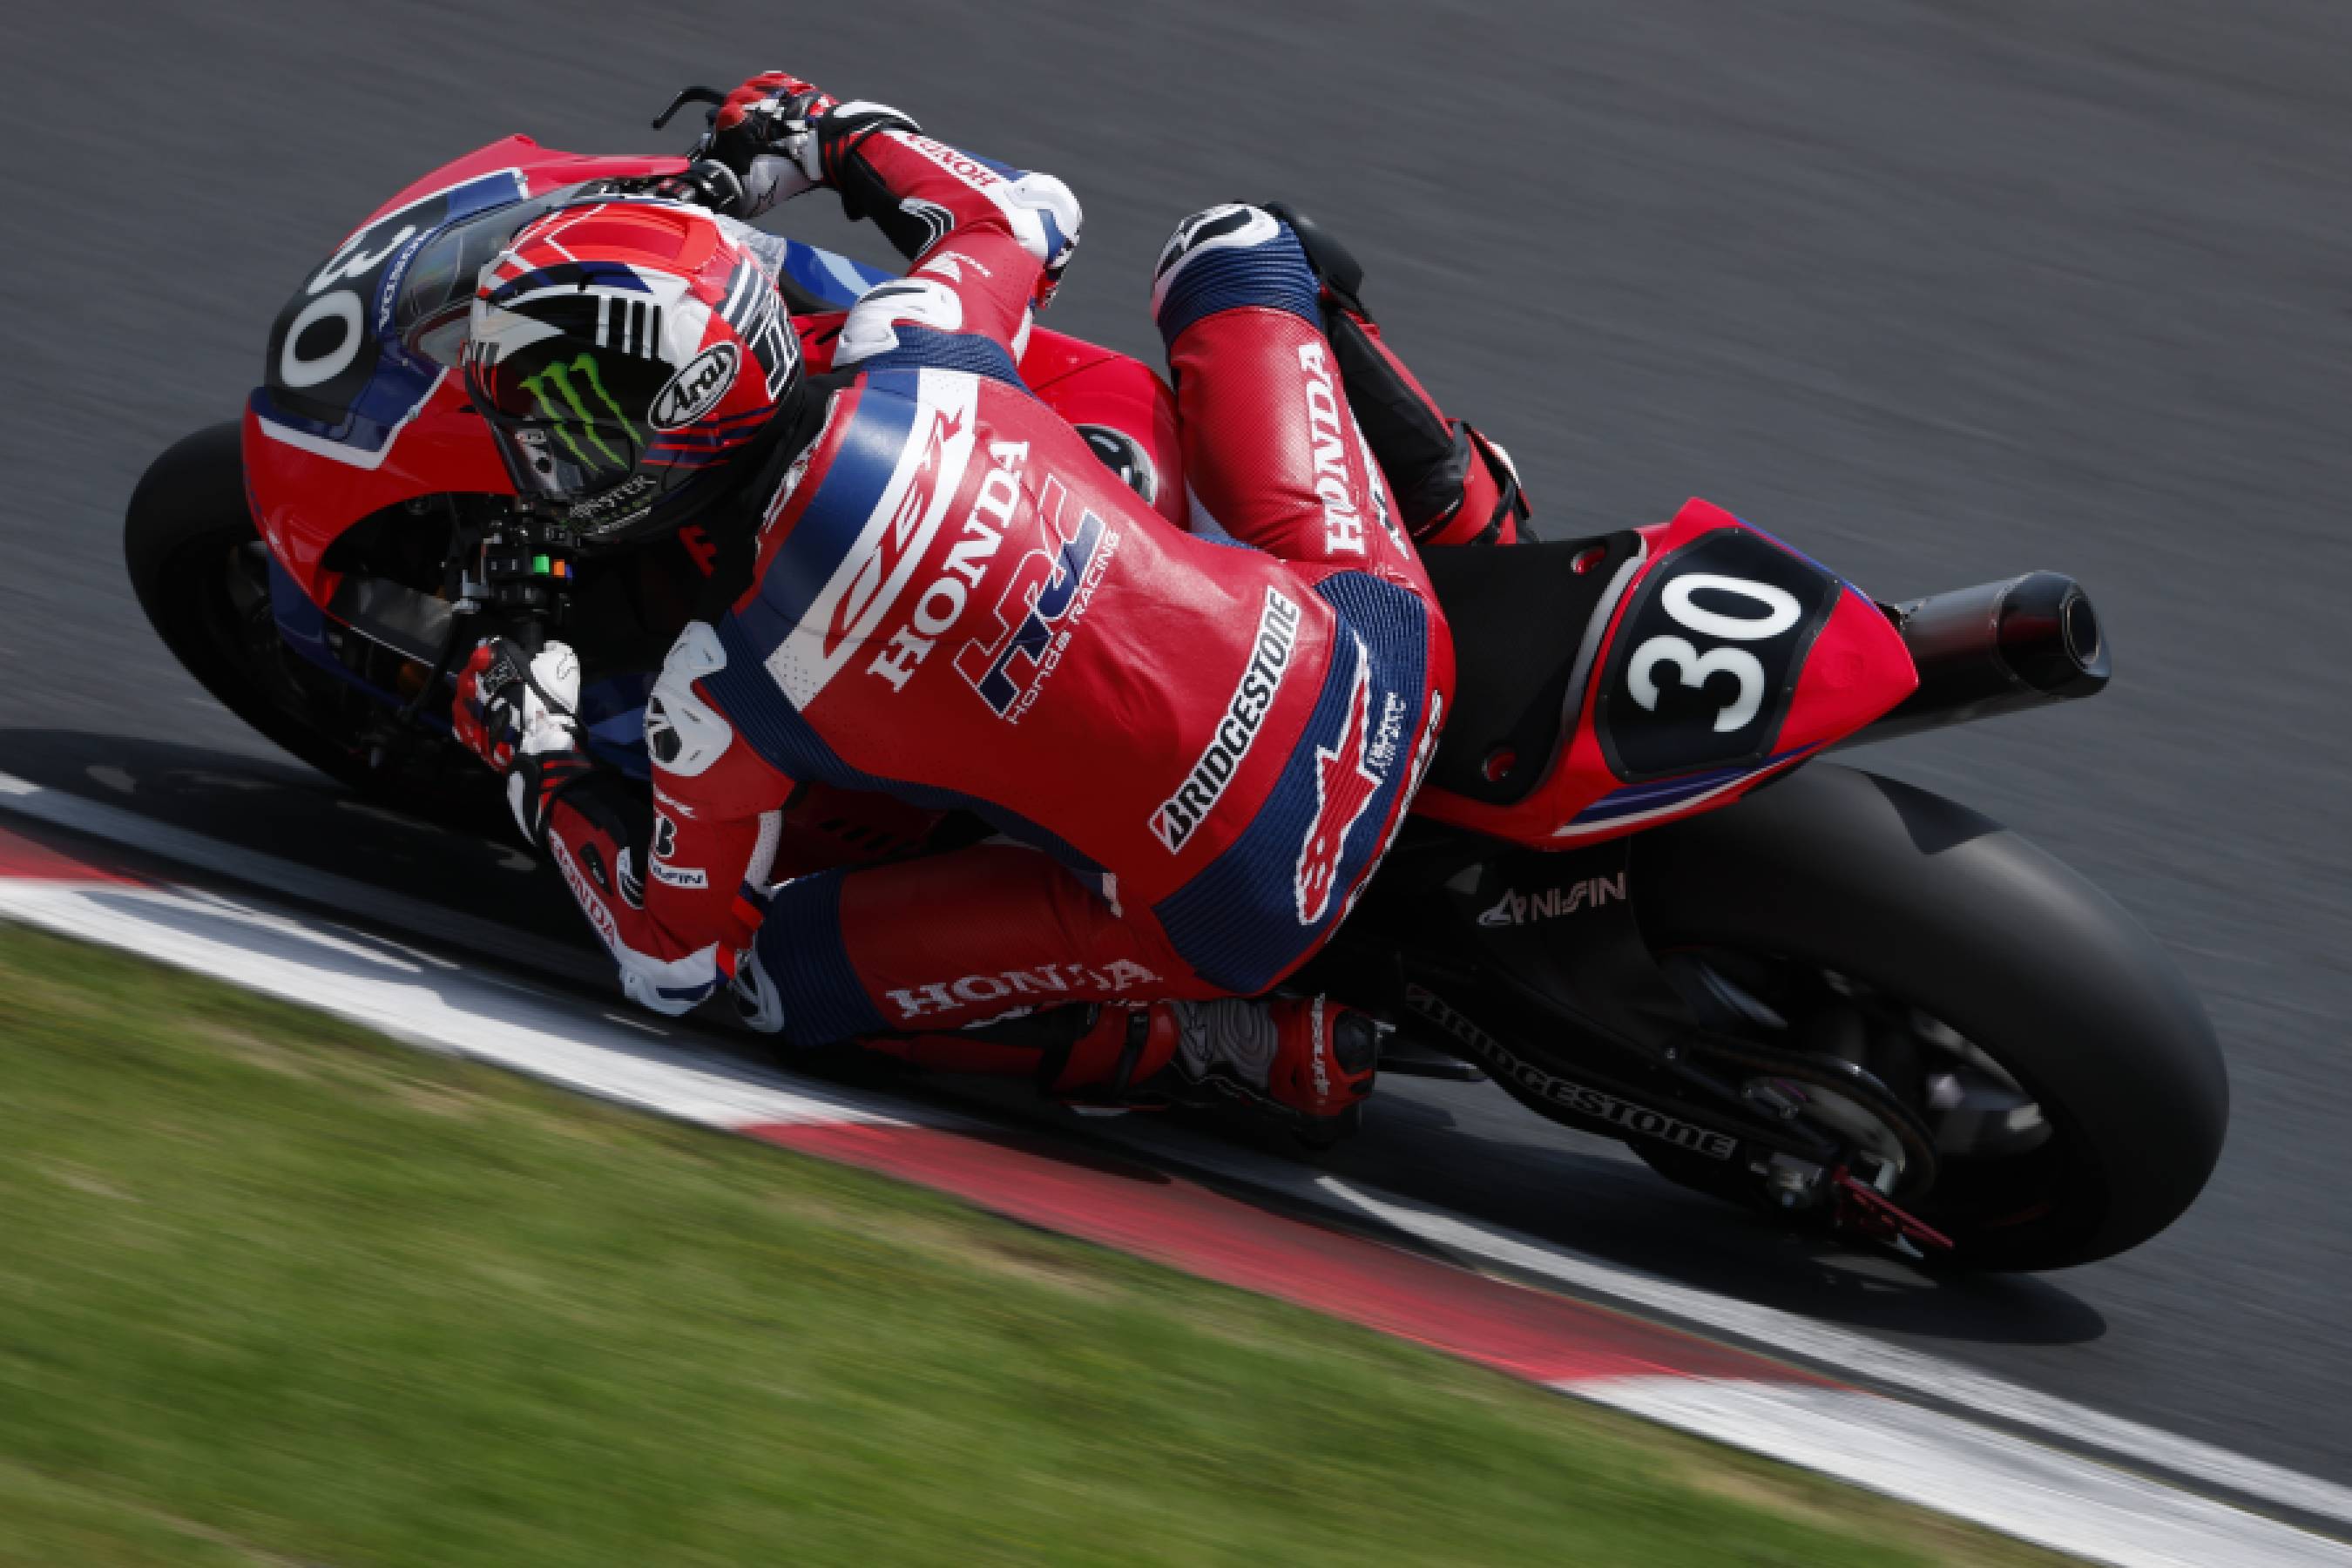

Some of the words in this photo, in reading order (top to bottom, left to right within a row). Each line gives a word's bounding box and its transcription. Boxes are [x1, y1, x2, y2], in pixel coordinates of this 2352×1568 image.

[280, 224, 416, 388] 30
[658, 348, 735, 424] Arai
[1297, 341, 1366, 555] HONDA
[867, 440, 1029, 693] HONDA
[951, 471, 1106, 720] HRC
[1067, 528, 1120, 625] RACING
[1160, 588, 1298, 852] BRIDGESTONE
[1626, 571, 1802, 733] 30
[1530, 870, 1626, 922] NISSIN
[1411, 988, 1738, 1160] BRIDGESTONE
